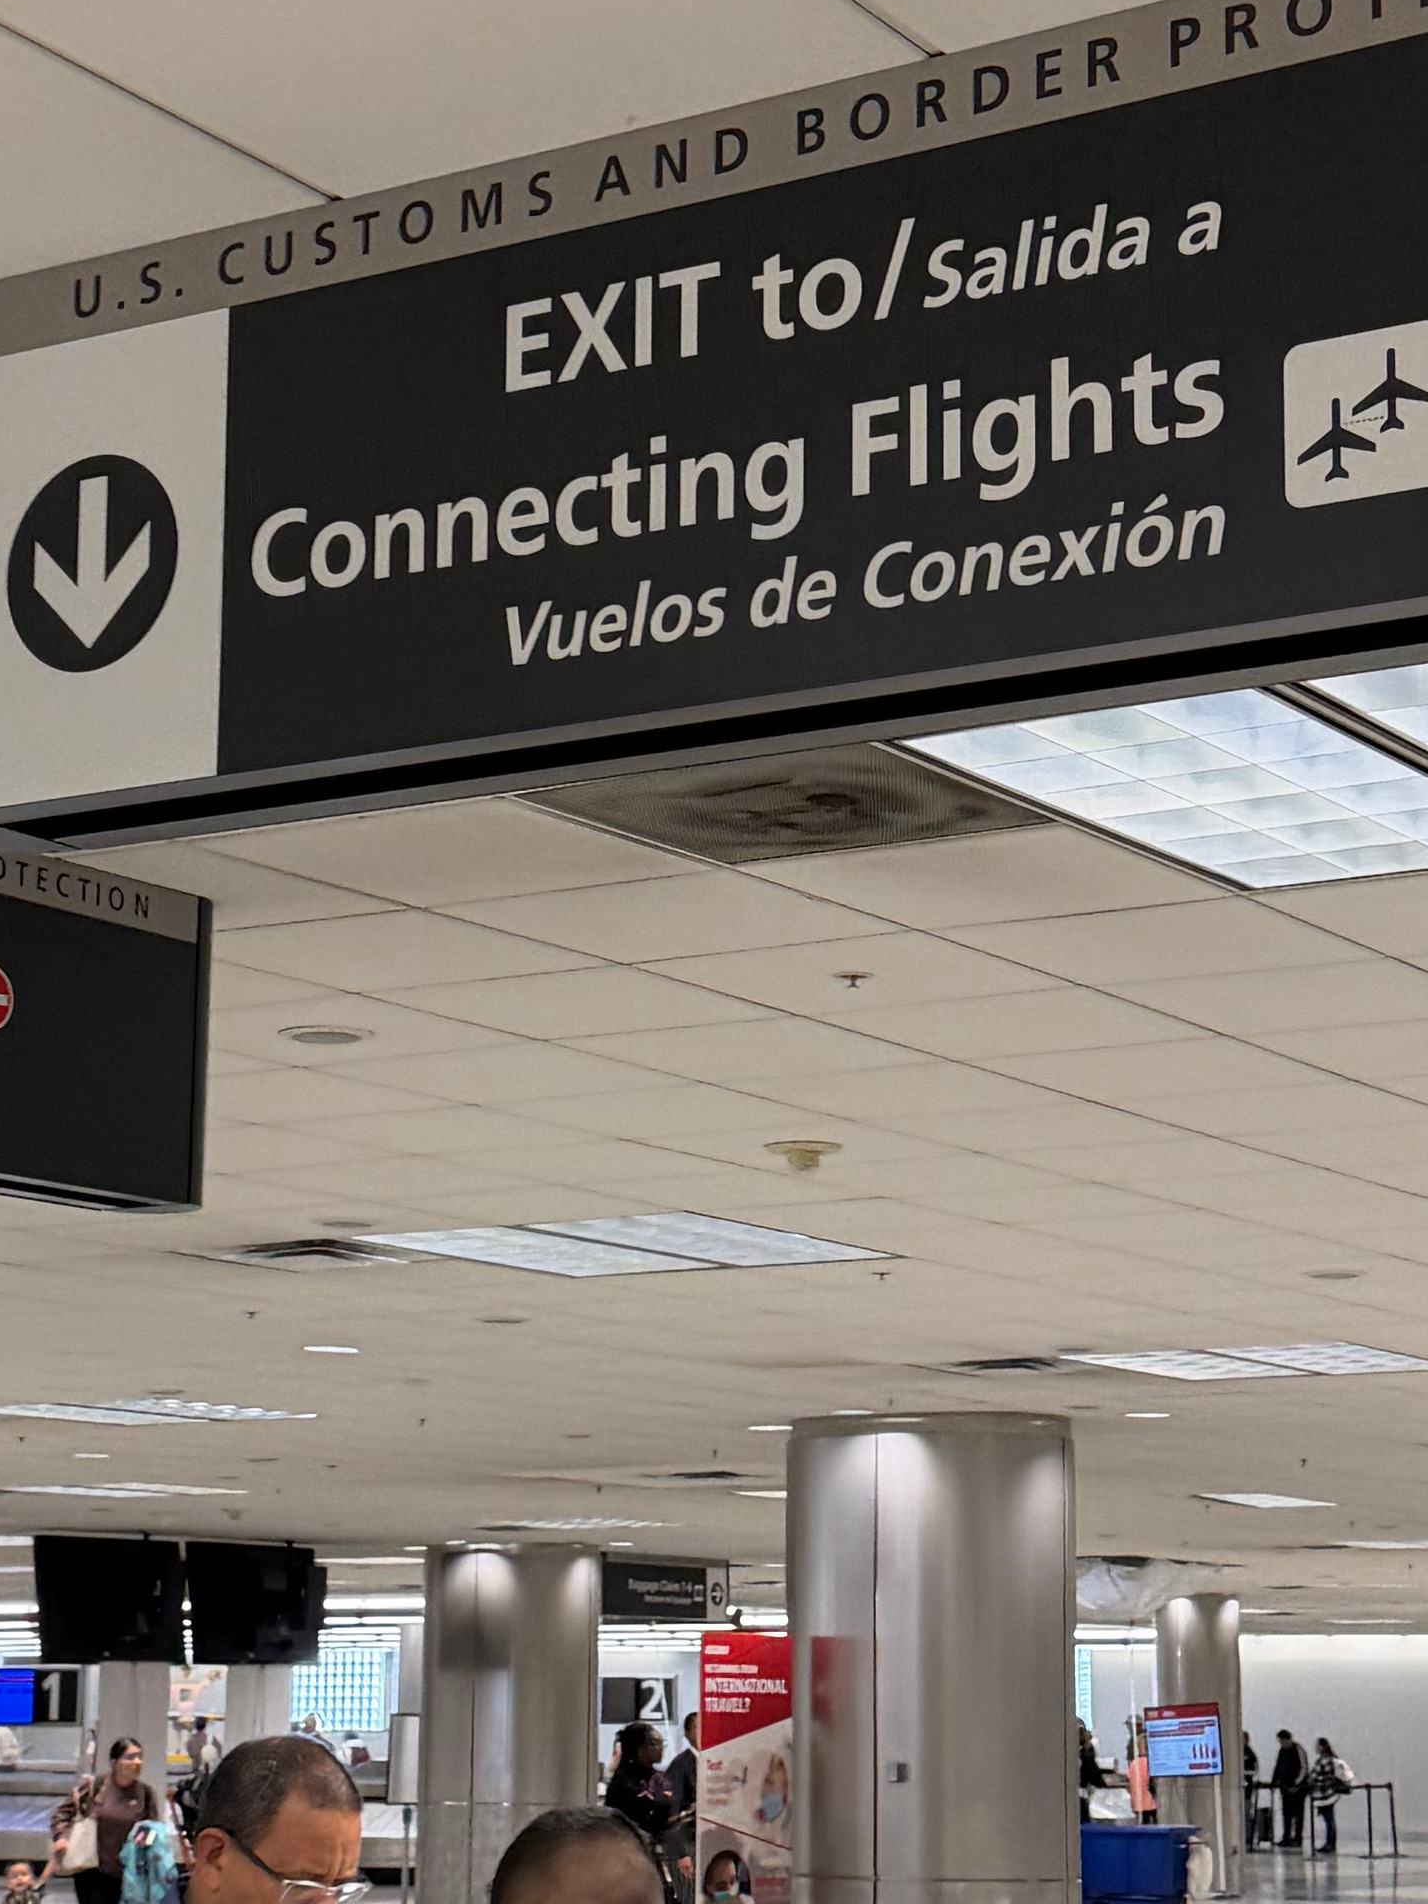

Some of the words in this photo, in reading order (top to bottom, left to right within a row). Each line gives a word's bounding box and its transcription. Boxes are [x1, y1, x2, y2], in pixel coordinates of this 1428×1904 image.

[72, 261, 184, 319] U.S.
[216, 171, 554, 286] CUSTOMS
[594, 127, 750, 203] AND
[795, 35, 1122, 156] BORDER
[504, 260, 722, 394] EXIT
[1176, 200, 1223, 255] a
[250, 434, 806, 598] Connecting
[851, 354, 1226, 502] Flights
[505, 581, 727, 667] Vuelos
[748, 557, 834, 629] de
[862, 493, 1226, 610] Conexión
[41, 1671, 61, 1721] 1
[639, 1679, 663, 1720] 2
